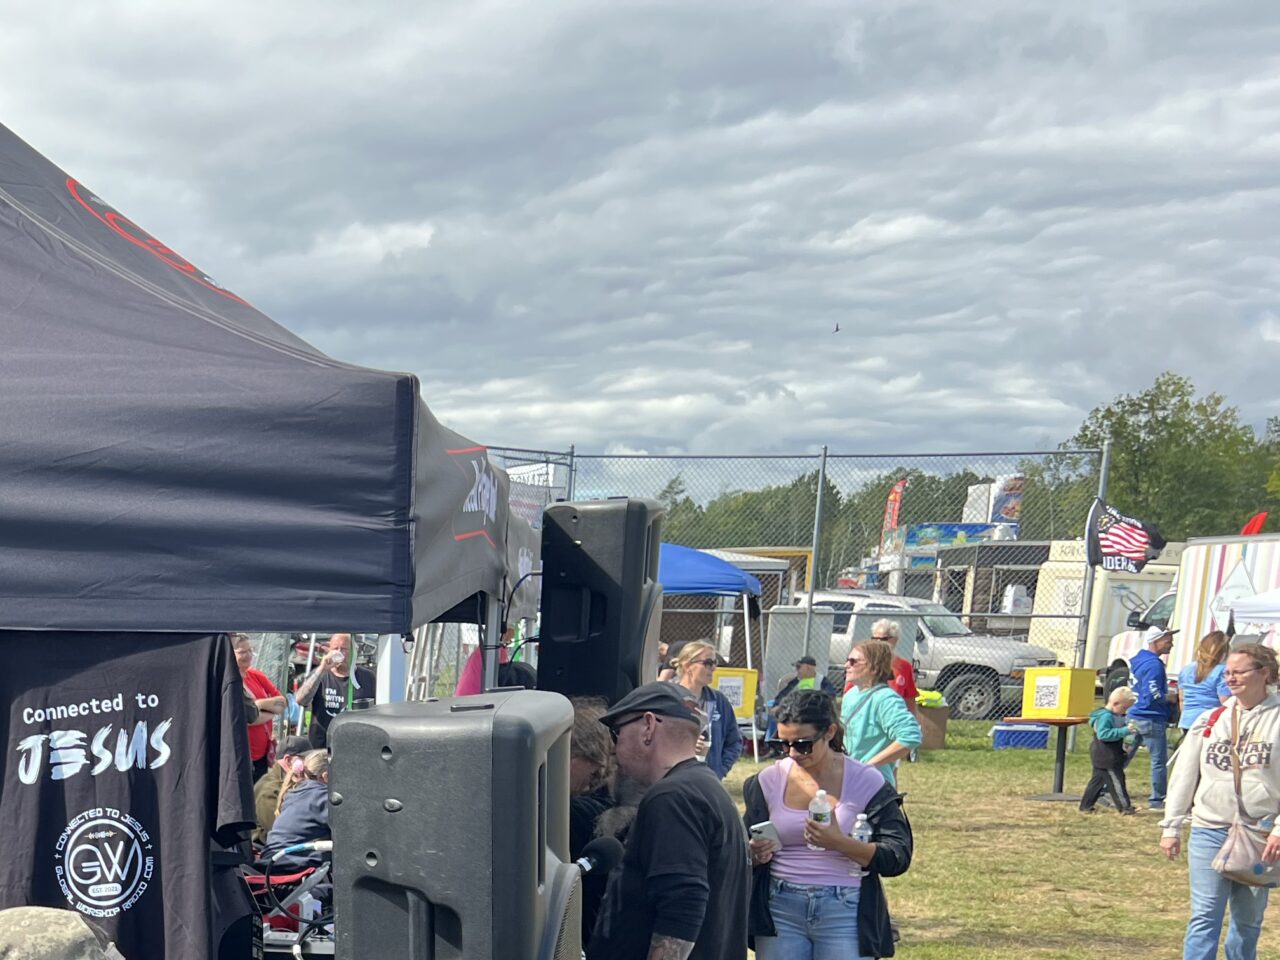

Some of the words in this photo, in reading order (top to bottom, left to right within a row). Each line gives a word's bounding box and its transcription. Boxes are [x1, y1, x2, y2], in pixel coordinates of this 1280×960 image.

[23, 693, 124, 724] Connected
[135, 693, 159, 709] to
[16, 717, 173, 785] JESUS
[56, 808, 103, 851] CONNECTED
[106, 807, 120, 819] TO
[120, 813, 150, 842] JESUS
[69, 839, 138, 885] GW
[55, 865, 75, 905] GLOBAL
[75, 902, 120, 918] WORSHIP
[122, 881, 148, 911] RADIO
